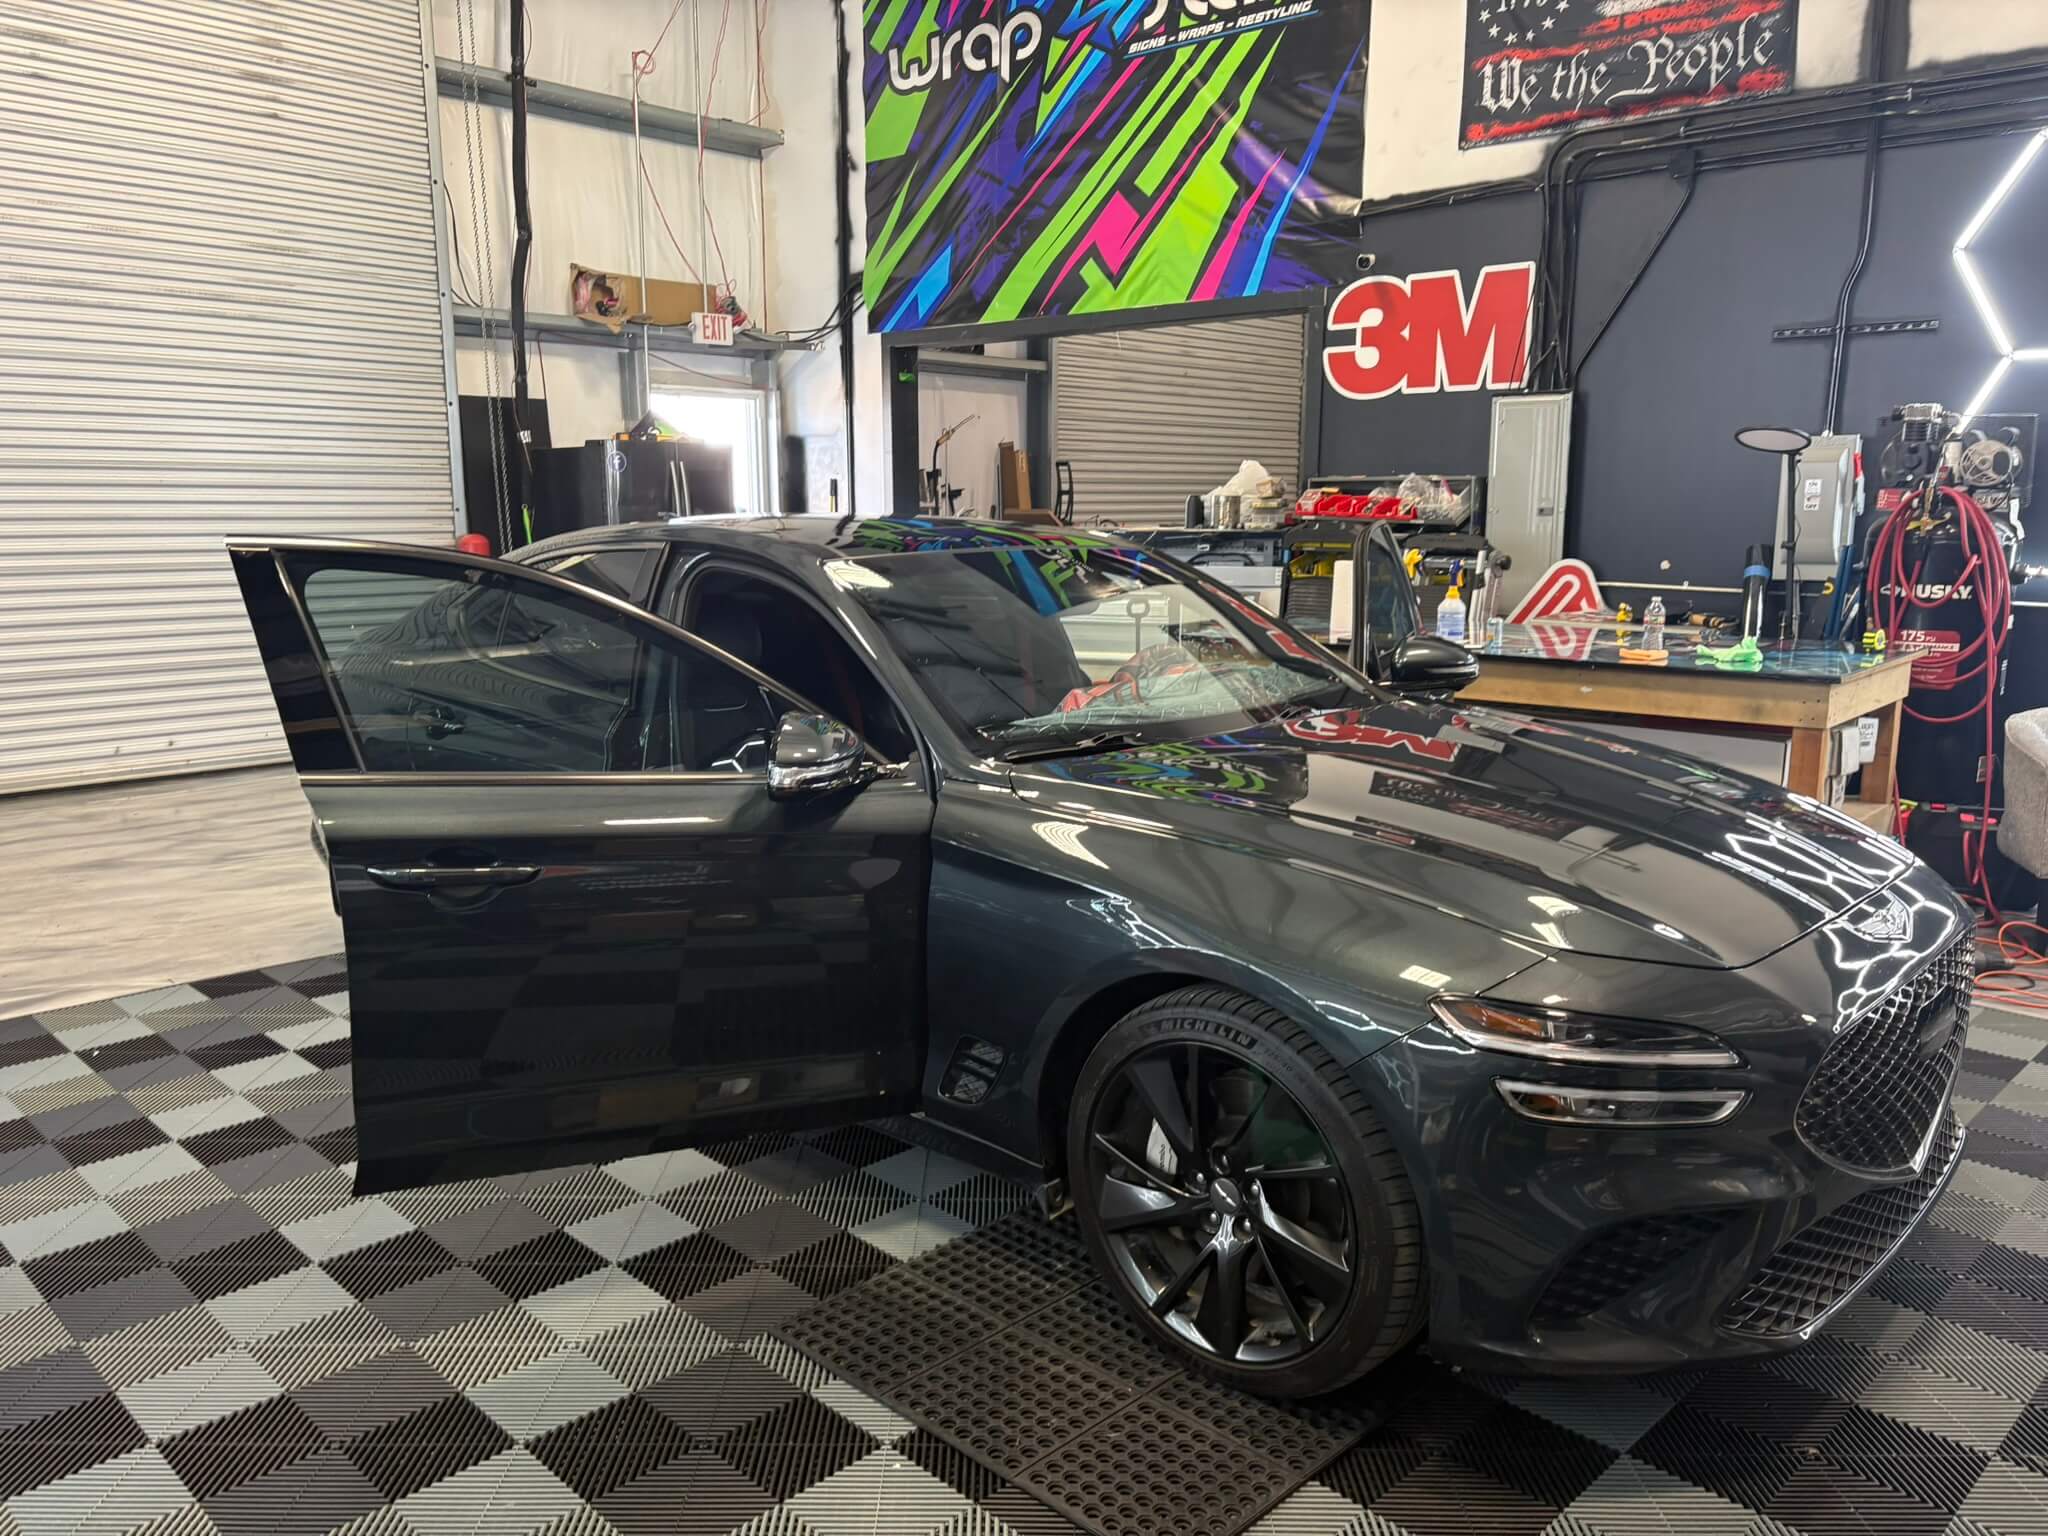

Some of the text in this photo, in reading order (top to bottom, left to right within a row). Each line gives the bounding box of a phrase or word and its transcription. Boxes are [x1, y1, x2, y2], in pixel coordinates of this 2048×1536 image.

[888, 11, 1042, 91] wrap
[1128, 35, 1167, 54] SIGNS
[1177, 20, 1225, 42] WRAPS
[1235, 1, 1313, 29] RESTYLING
[1477, 12, 1775, 114] We the People
[703, 315, 728, 341] EXIT
[1323, 261, 1537, 400] 3M
[1901, 630, 1925, 642] 175
[1160, 1018, 1251, 1046] MICHELIN
